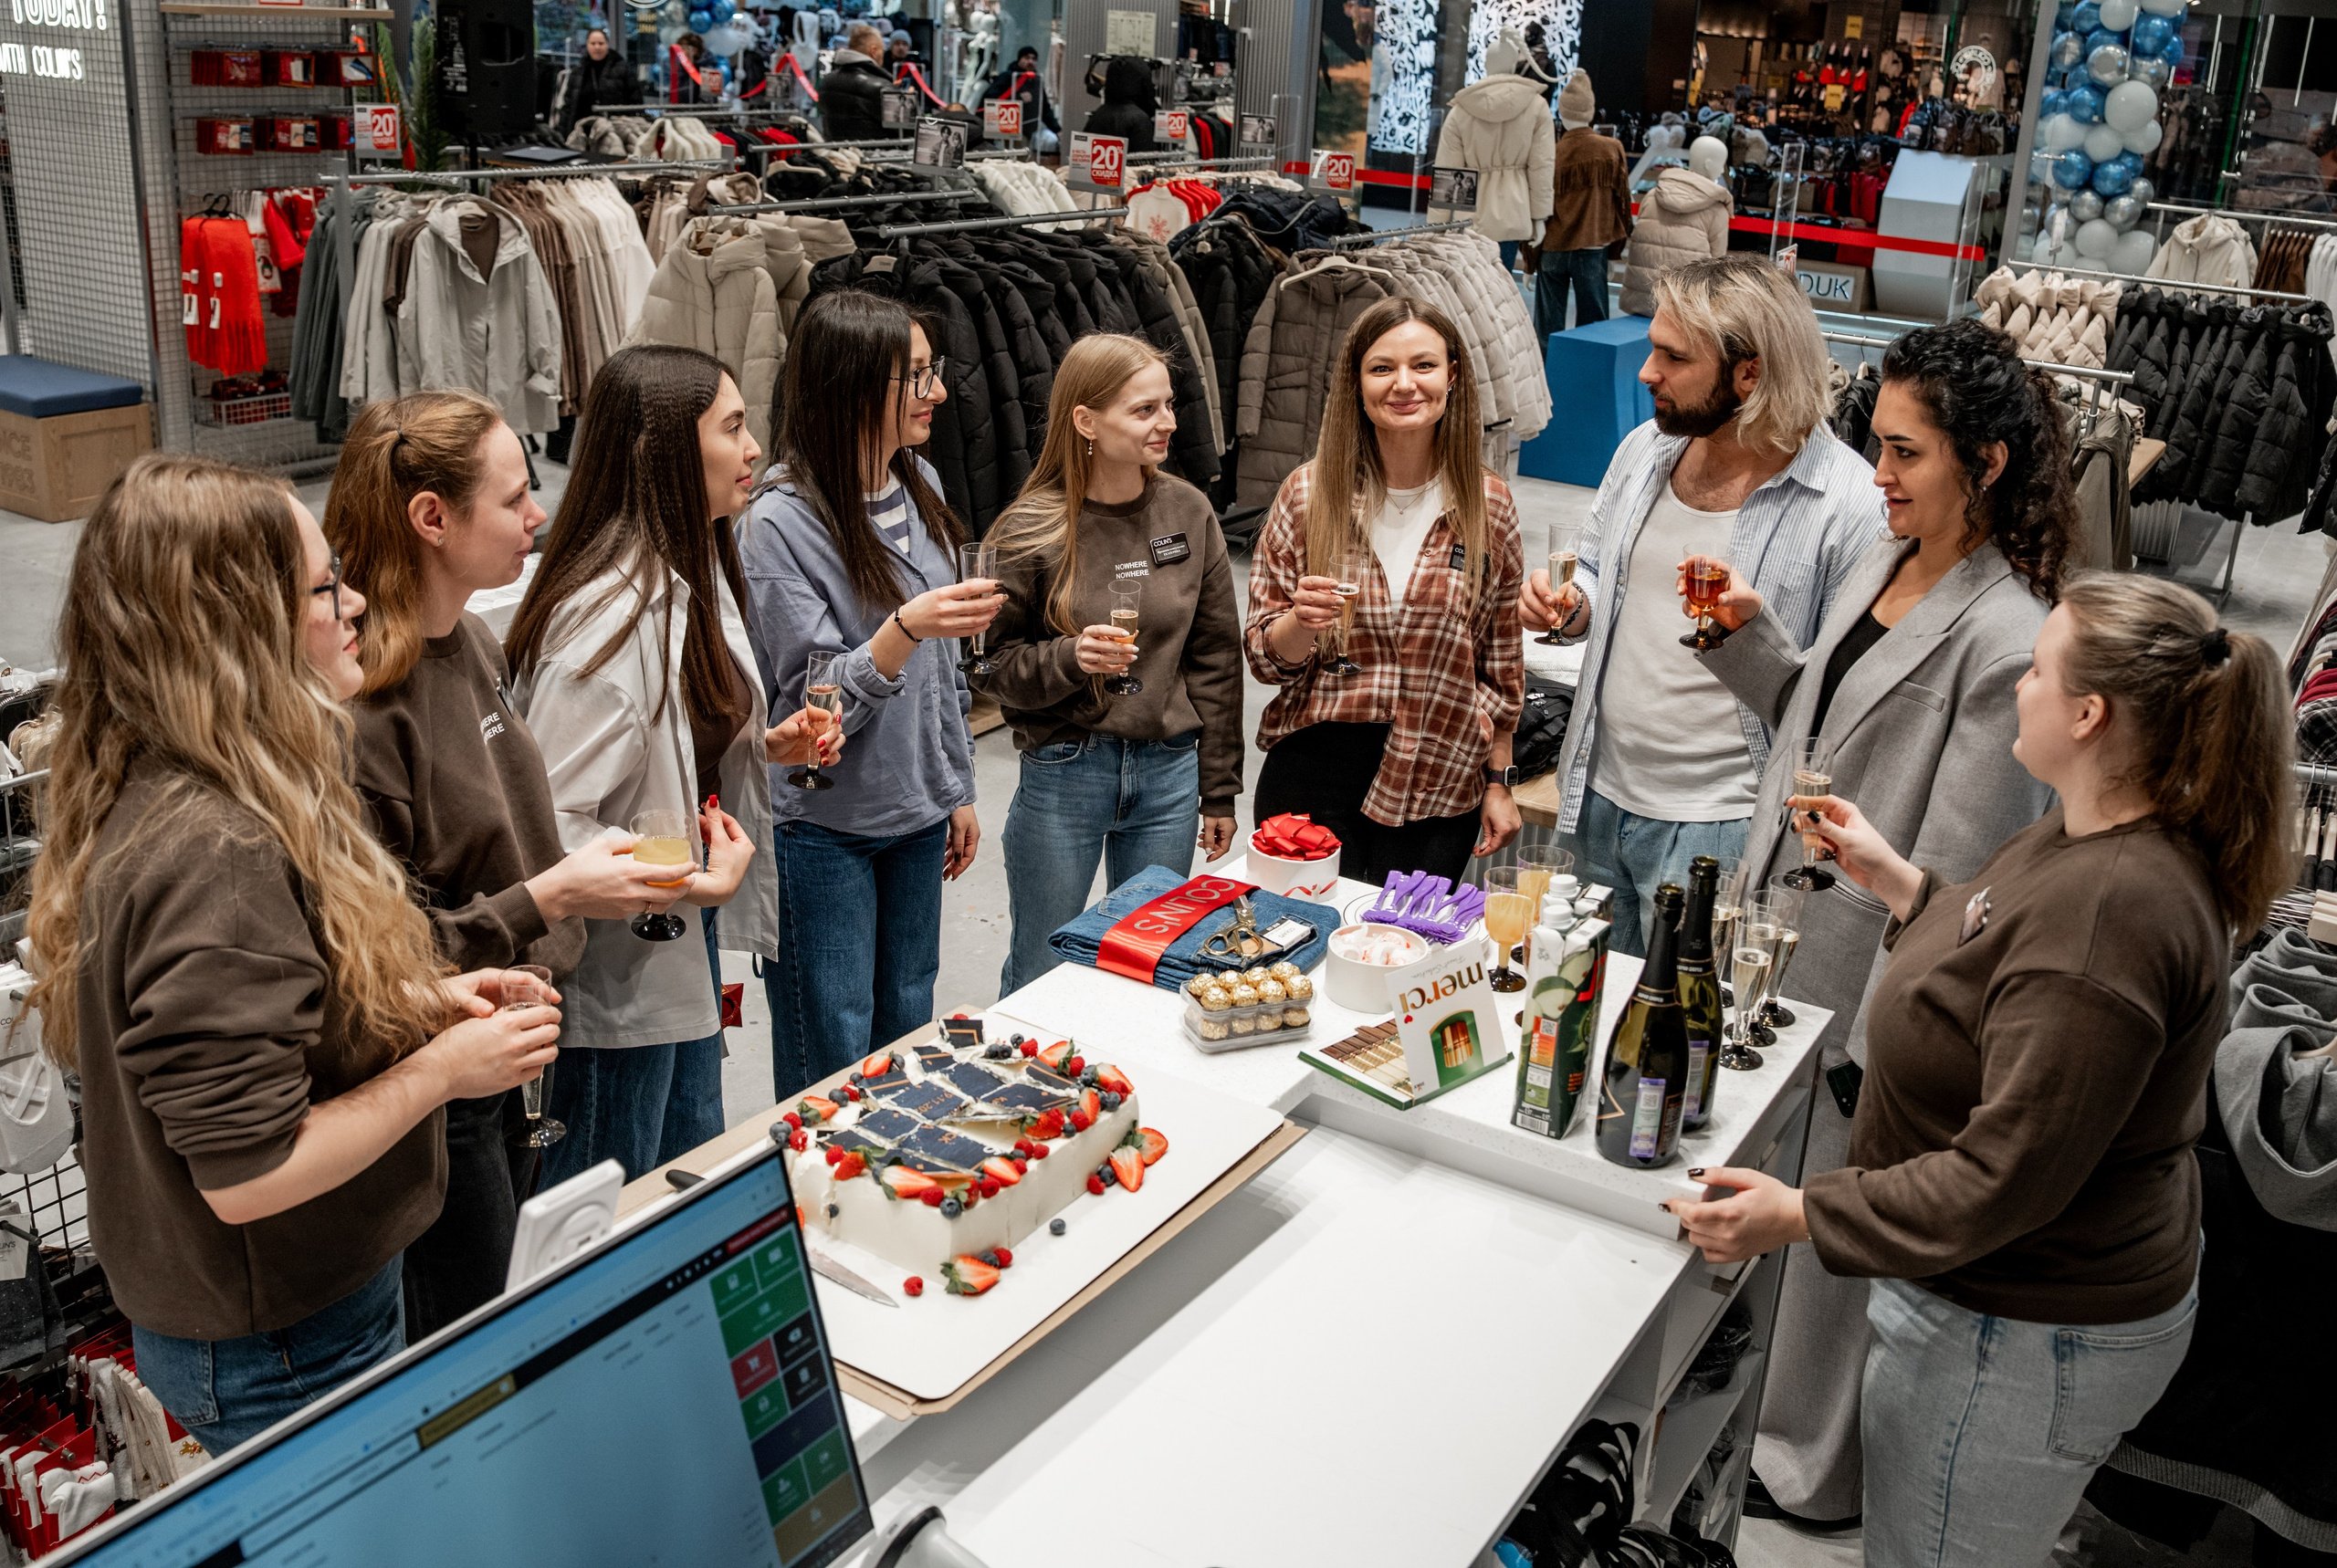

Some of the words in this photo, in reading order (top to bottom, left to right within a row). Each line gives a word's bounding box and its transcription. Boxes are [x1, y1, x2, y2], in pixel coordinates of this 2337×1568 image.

[1092, 169, 1118, 179] СКИДКА
[1115, 560, 1148, 570] NOWHERE
[1116, 569, 1149, 580] NOWHERE
[1134, 879, 1236, 934] COLIN'S
[1399, 962, 1484, 1023] merci
